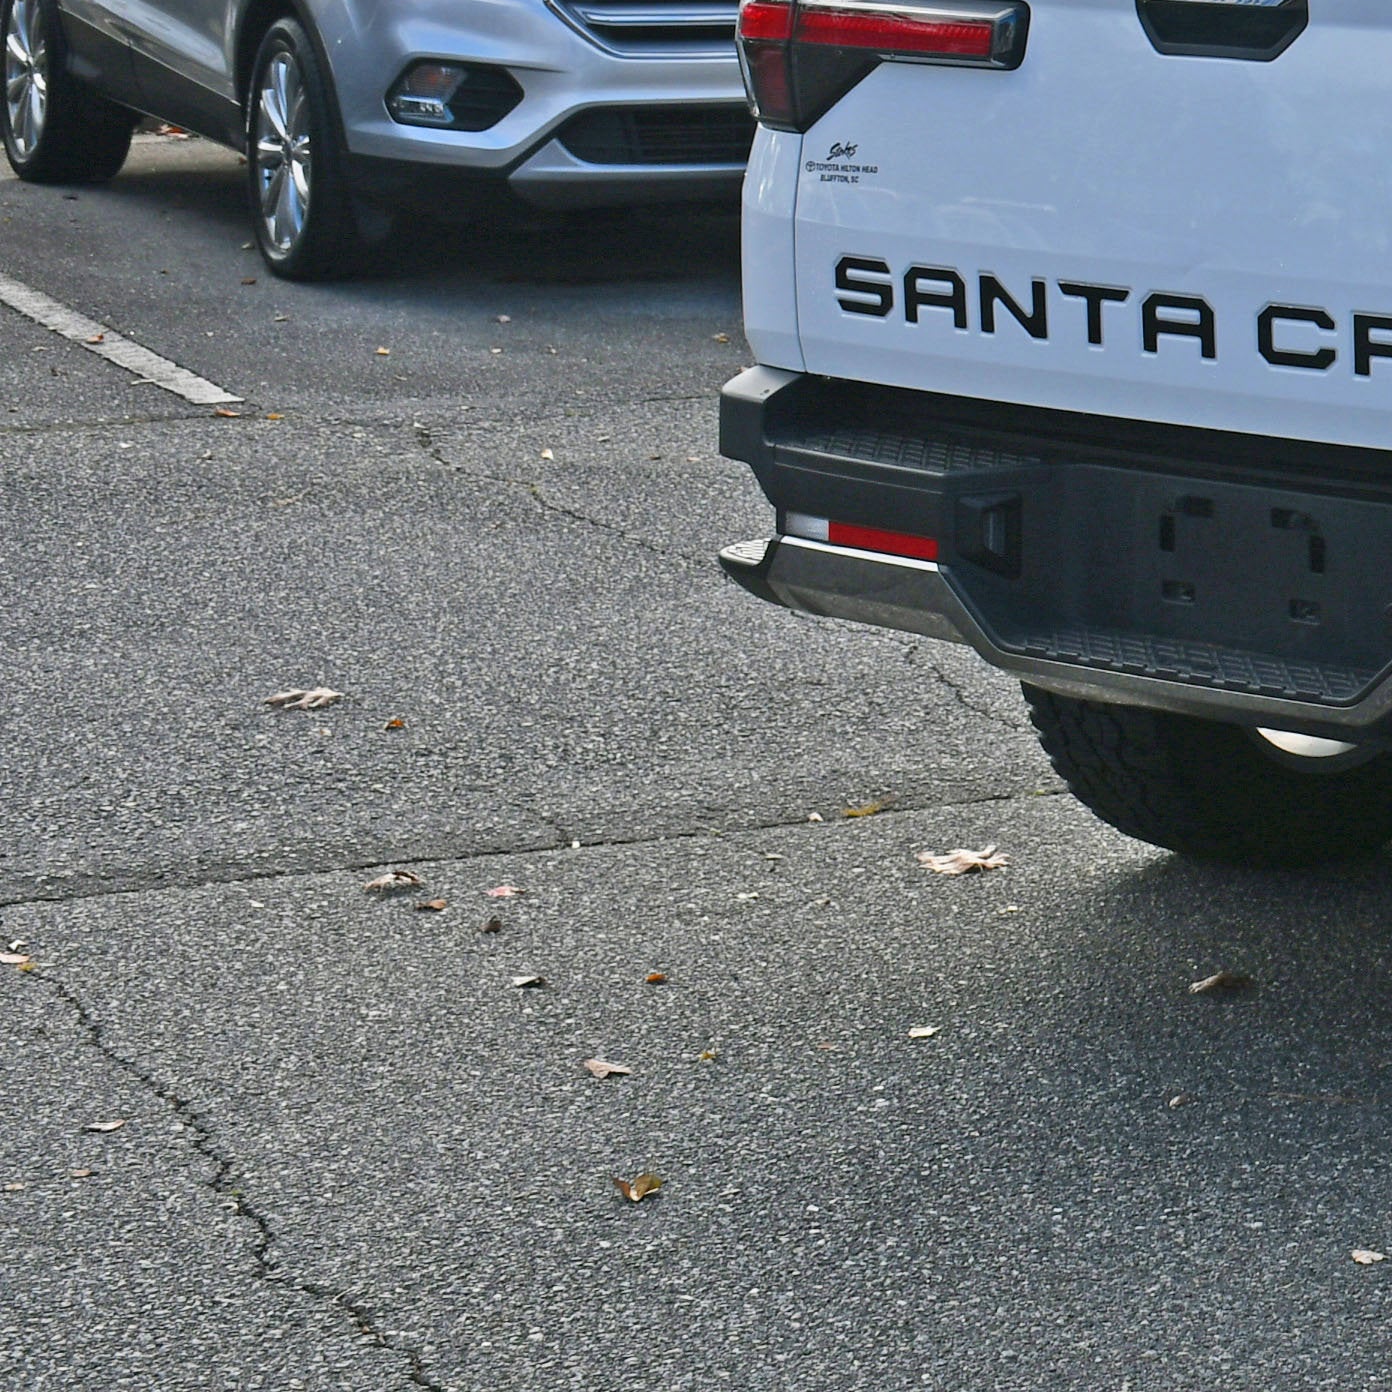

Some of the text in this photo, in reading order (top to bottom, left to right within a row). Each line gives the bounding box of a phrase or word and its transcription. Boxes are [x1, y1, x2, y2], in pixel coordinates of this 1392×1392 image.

[816, 163, 879, 174] TOYOTA HILTON HEAD
[850, 175, 860, 184] SC
[834, 255, 1217, 360] SANTA
